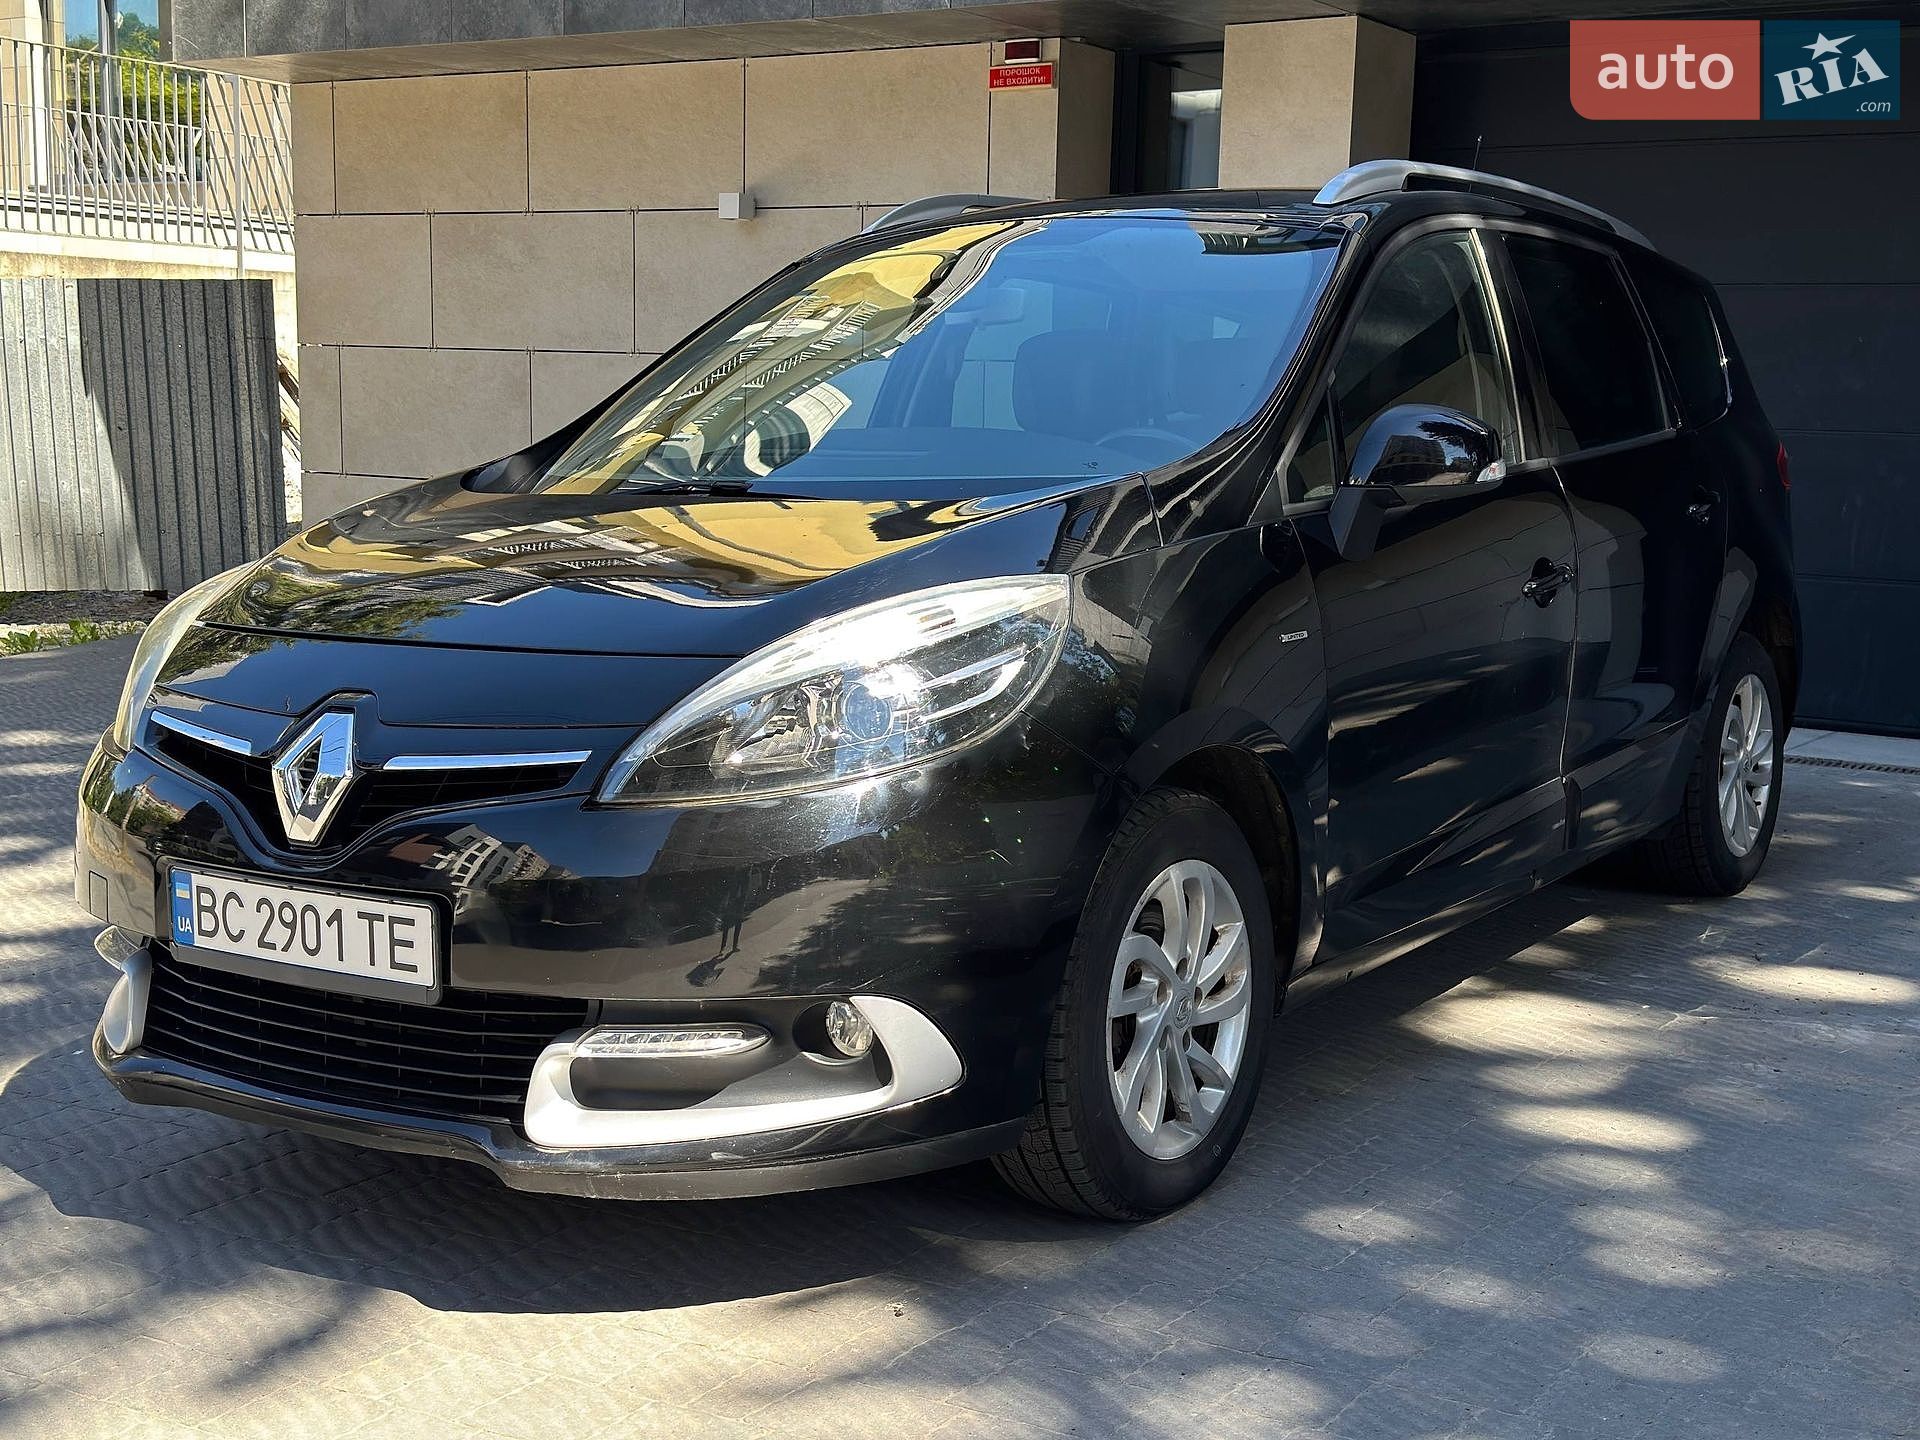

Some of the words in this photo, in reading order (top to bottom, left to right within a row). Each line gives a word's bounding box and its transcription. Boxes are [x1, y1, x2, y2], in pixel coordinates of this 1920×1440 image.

[1000, 67, 1041, 77] ПОРОШОК
[1006, 77, 1046, 86] ВХОДИТИ!
[178, 916, 193, 933] UA
[195, 885, 245, 943] BC
[256, 898, 344, 962] 2901
[357, 911, 418, 973] TE
